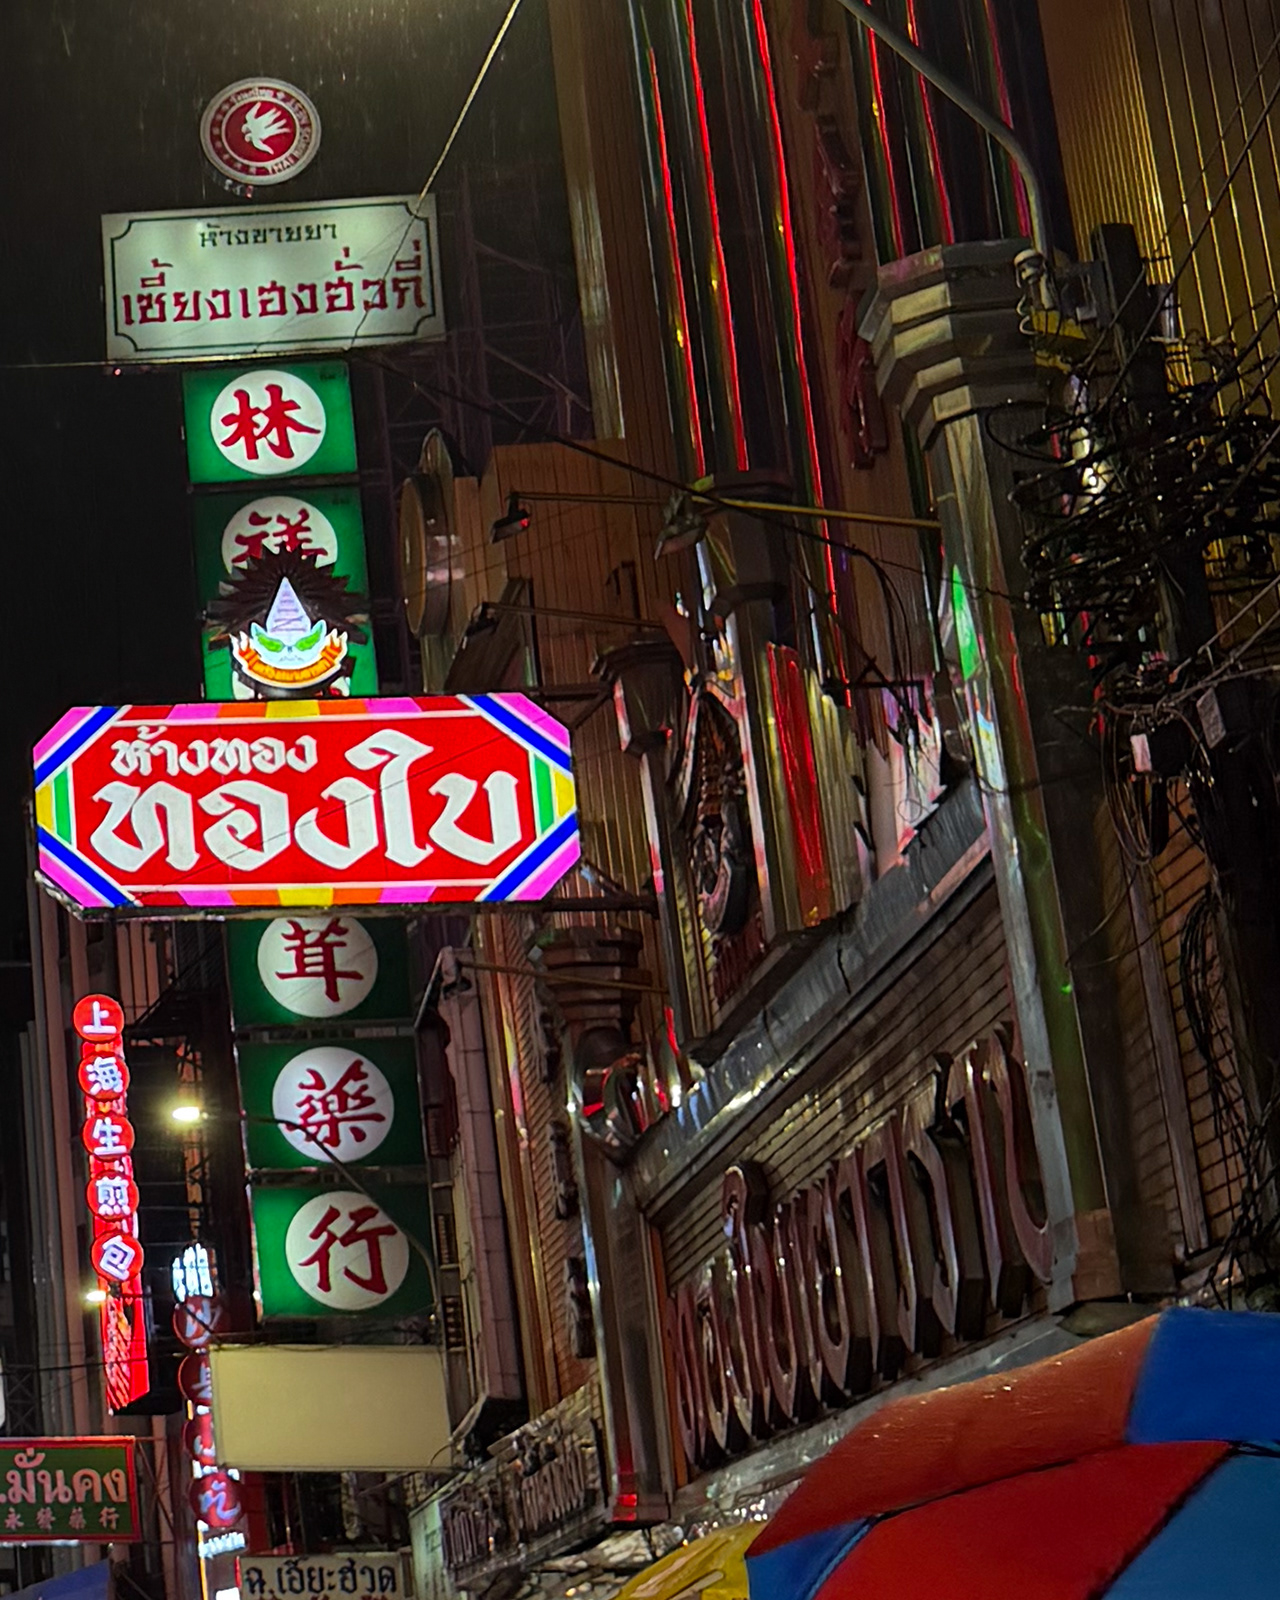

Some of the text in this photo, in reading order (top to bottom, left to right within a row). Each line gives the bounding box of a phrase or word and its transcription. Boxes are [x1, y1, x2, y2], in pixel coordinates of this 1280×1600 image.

[199, 222, 338, 248] ห้างขายยา
[90, 728, 524, 872] ทองใบ
[110, 725, 319, 777] ห้างทอง
[82, 1001, 138, 1279] 上海生煎包
